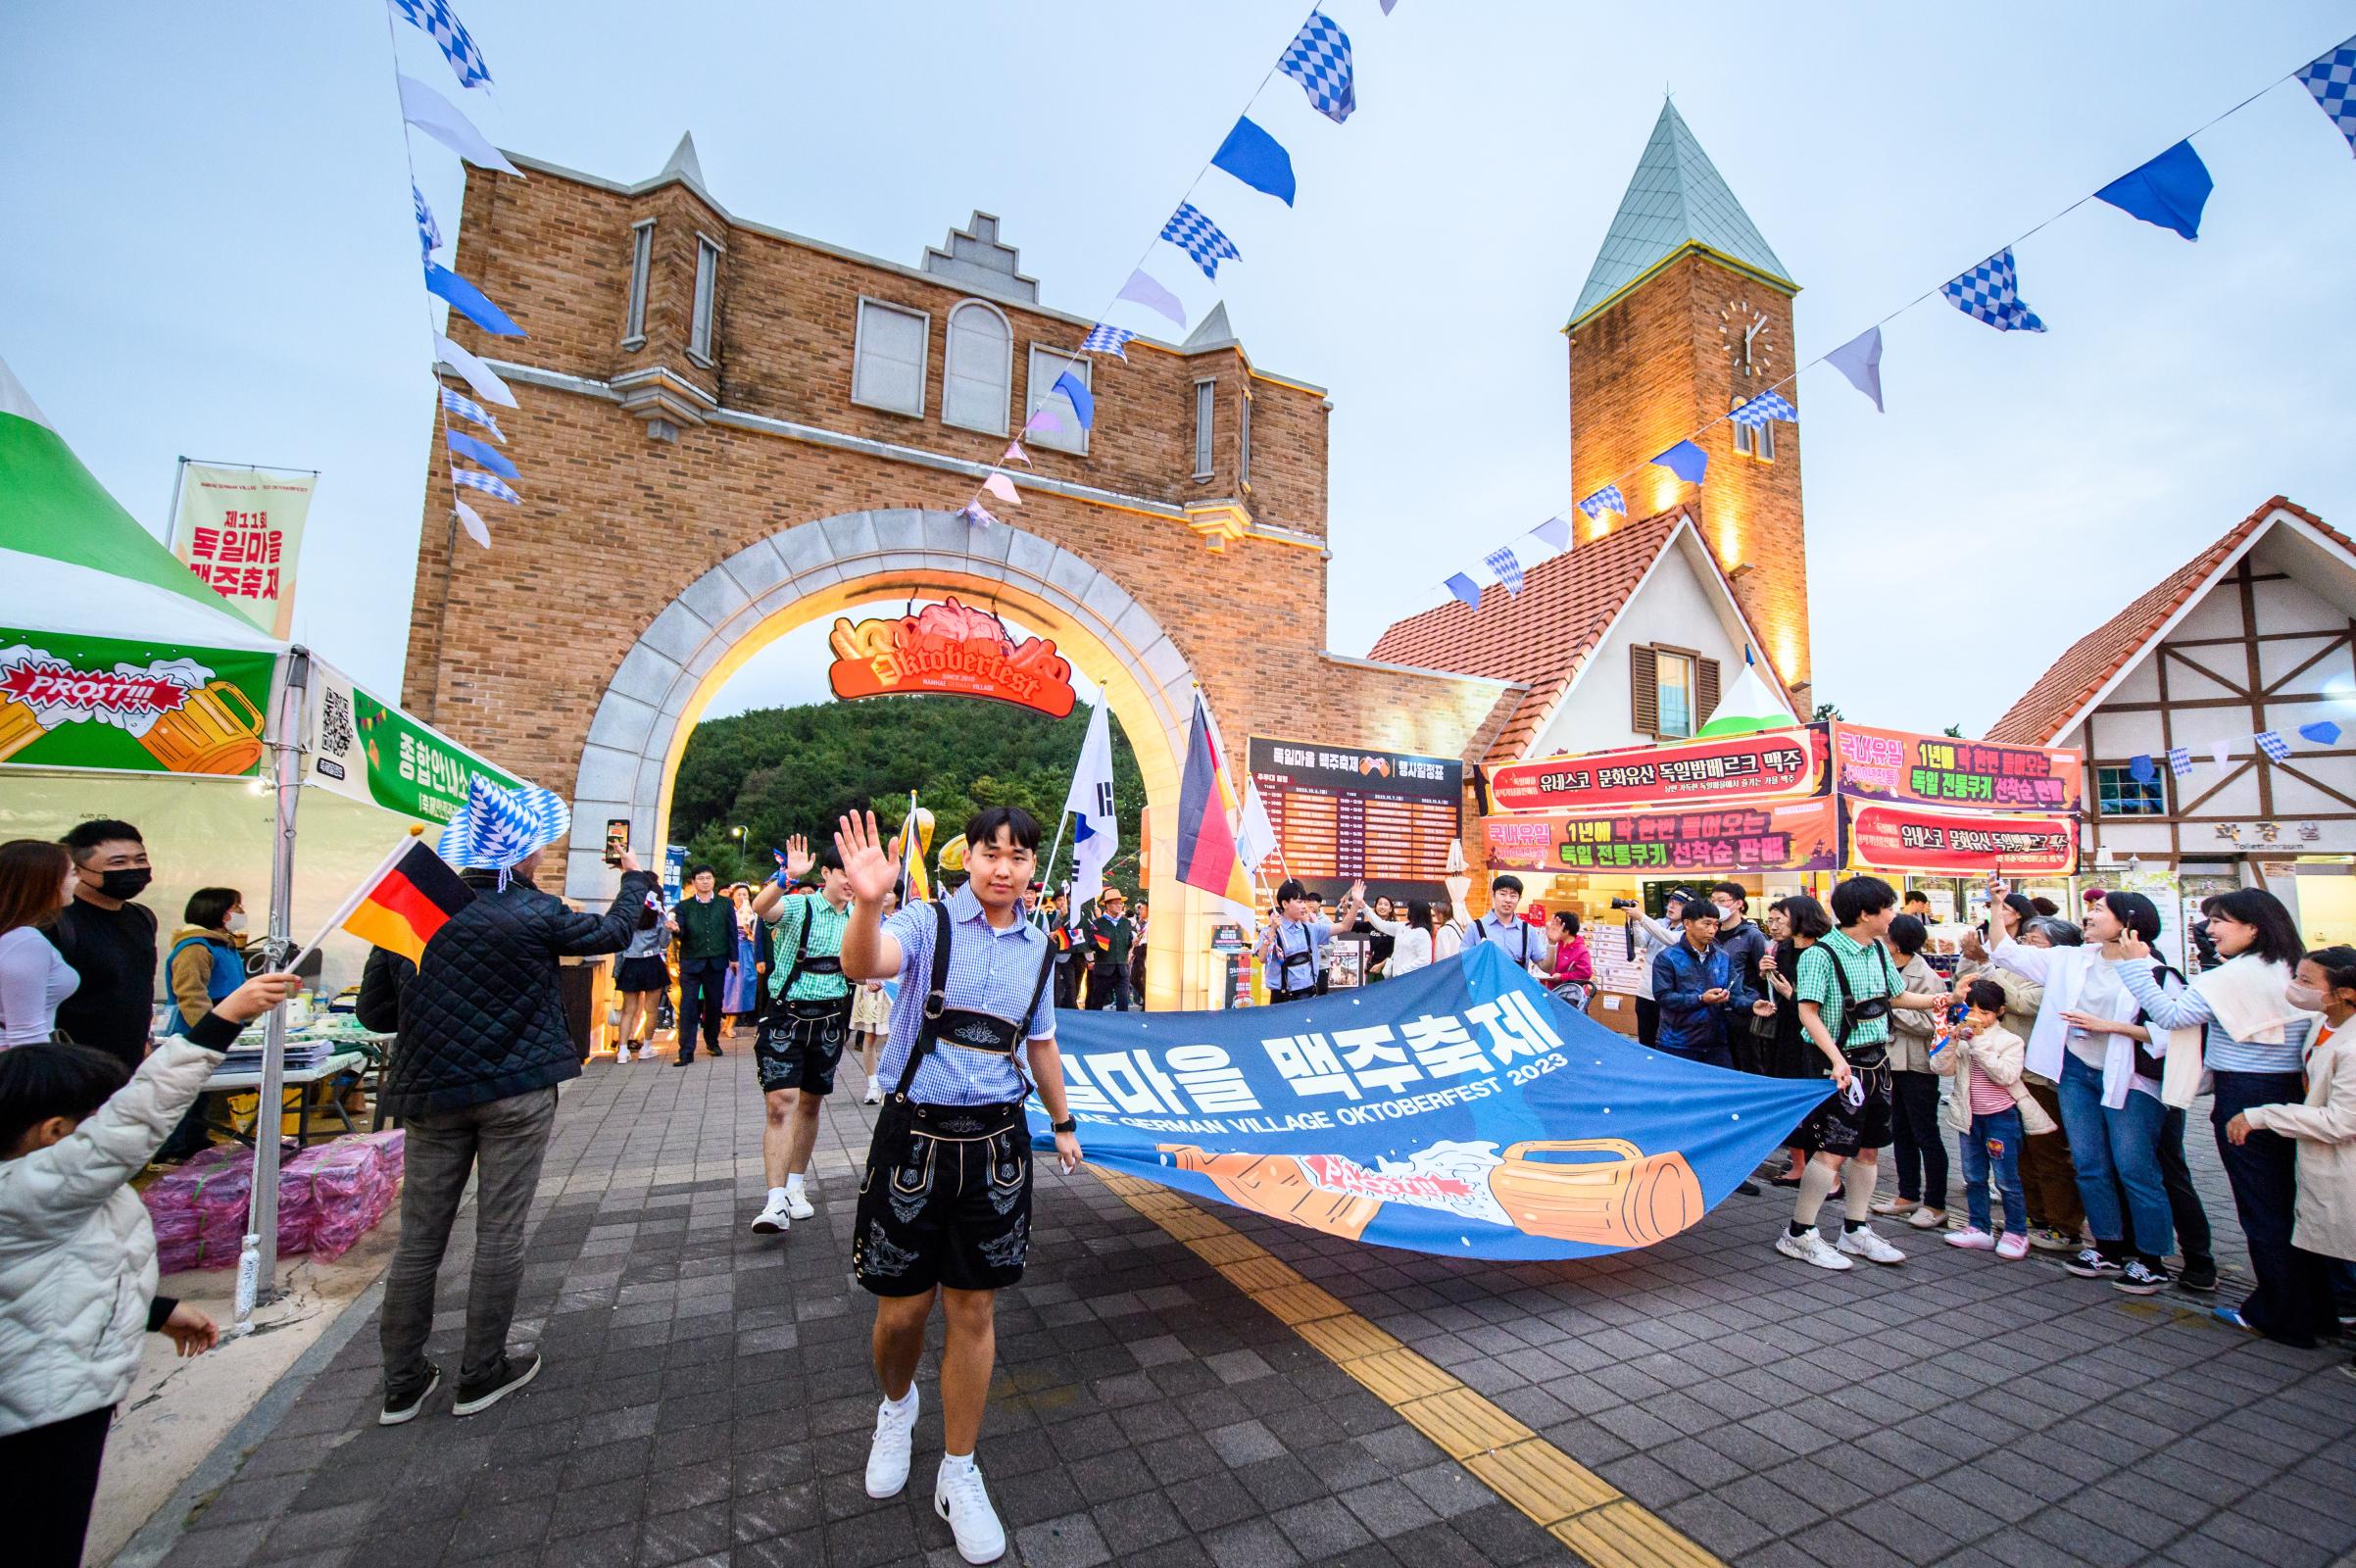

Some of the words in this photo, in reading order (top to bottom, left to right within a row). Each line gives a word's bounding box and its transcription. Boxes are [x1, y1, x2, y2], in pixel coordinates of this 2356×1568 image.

[224, 510, 268, 529] 제11회
[192, 526, 283, 564] 독일마을
[870, 643, 1042, 701] Oktoberfest
[922, 678, 948, 687] NAMHAE
[971, 683, 996, 692] VILLAGE
[26, 676, 155, 705] PROST!!!
[1273, 747, 1315, 768] 독일마을
[1319, 752, 1359, 773] 맥주축제
[1399, 760, 1445, 781] 행사일정표
[1839, 732, 1903, 767] 국내유일
[1919, 743, 1955, 770] 1년에
[399, 731, 468, 801] 종합안내소
[1540, 771, 1592, 792] 유네스코
[1597, 764, 1655, 788] 문화유산
[1658, 754, 1760, 783] 독일밤베르크
[1762, 750, 1802, 772] 맥주
[1764, 776, 1779, 785] 가을
[1780, 774, 1795, 784] 맥주
[1911, 768, 1939, 796] 독일
[1942, 772, 1992, 800] 전통쿠키
[1994, 776, 2036, 802] 선착순
[1489, 823, 1550, 846] 국내유일
[1568, 821, 1611, 843] 1년에
[1638, 817, 1676, 841] 한번
[1901, 825, 1945, 848] 유네스코
[1949, 830, 1993, 852] 문화유산
[1560, 845, 1594, 865] 독일
[1596, 843, 1667, 865] 전통쿠키
[1673, 840, 1733, 865] 선착순
[1738, 836, 1785, 862] 판매
[1261, 990, 1565, 1101] 맥주축제
[1120, 1116, 1227, 1135] GERMAN
[1227, 1110, 1337, 1135] VILLAGE
[1337, 1076, 1503, 1126] OKTOBERFEST
[1505, 1053, 1569, 1087] 2023
